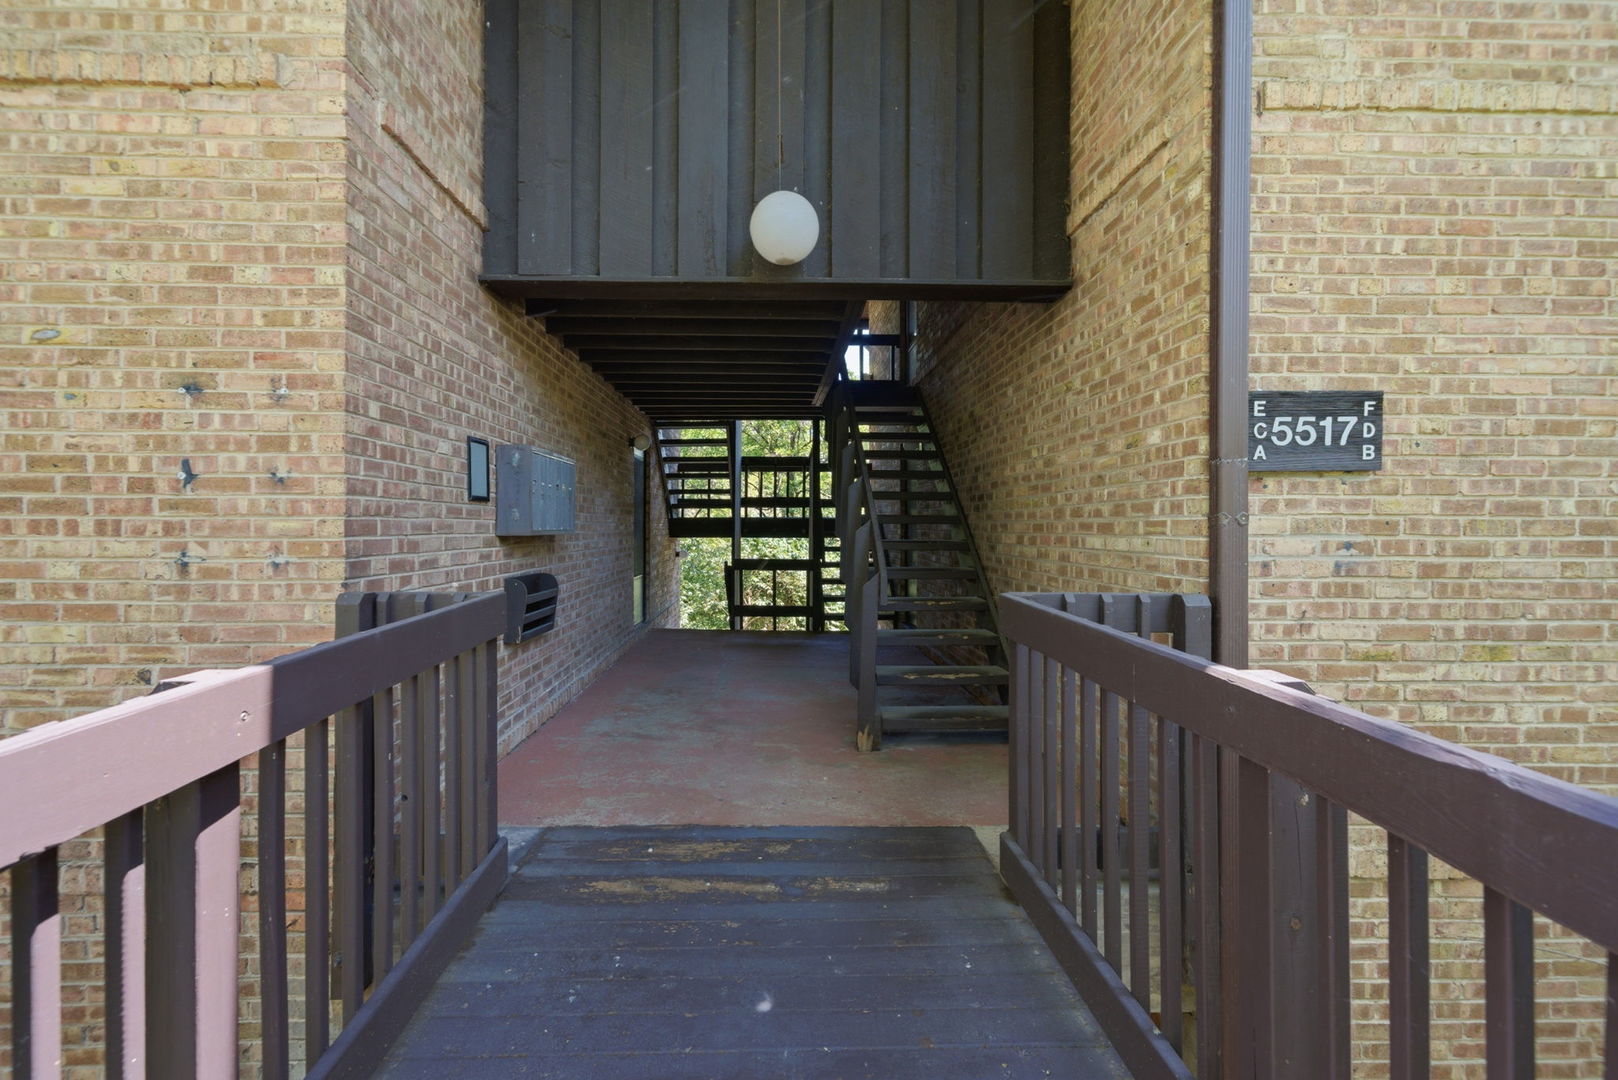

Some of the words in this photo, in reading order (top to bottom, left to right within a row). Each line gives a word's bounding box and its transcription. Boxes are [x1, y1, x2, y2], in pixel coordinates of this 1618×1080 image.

[1253, 400, 1267, 417] E
[1363, 401, 1377, 417] F
[1253, 422, 1268, 439] C
[1270, 416, 1359, 446] 5517
[1362, 422, 1376, 438] D
[1253, 444, 1267, 460] A
[1362, 444, 1376, 460] B
